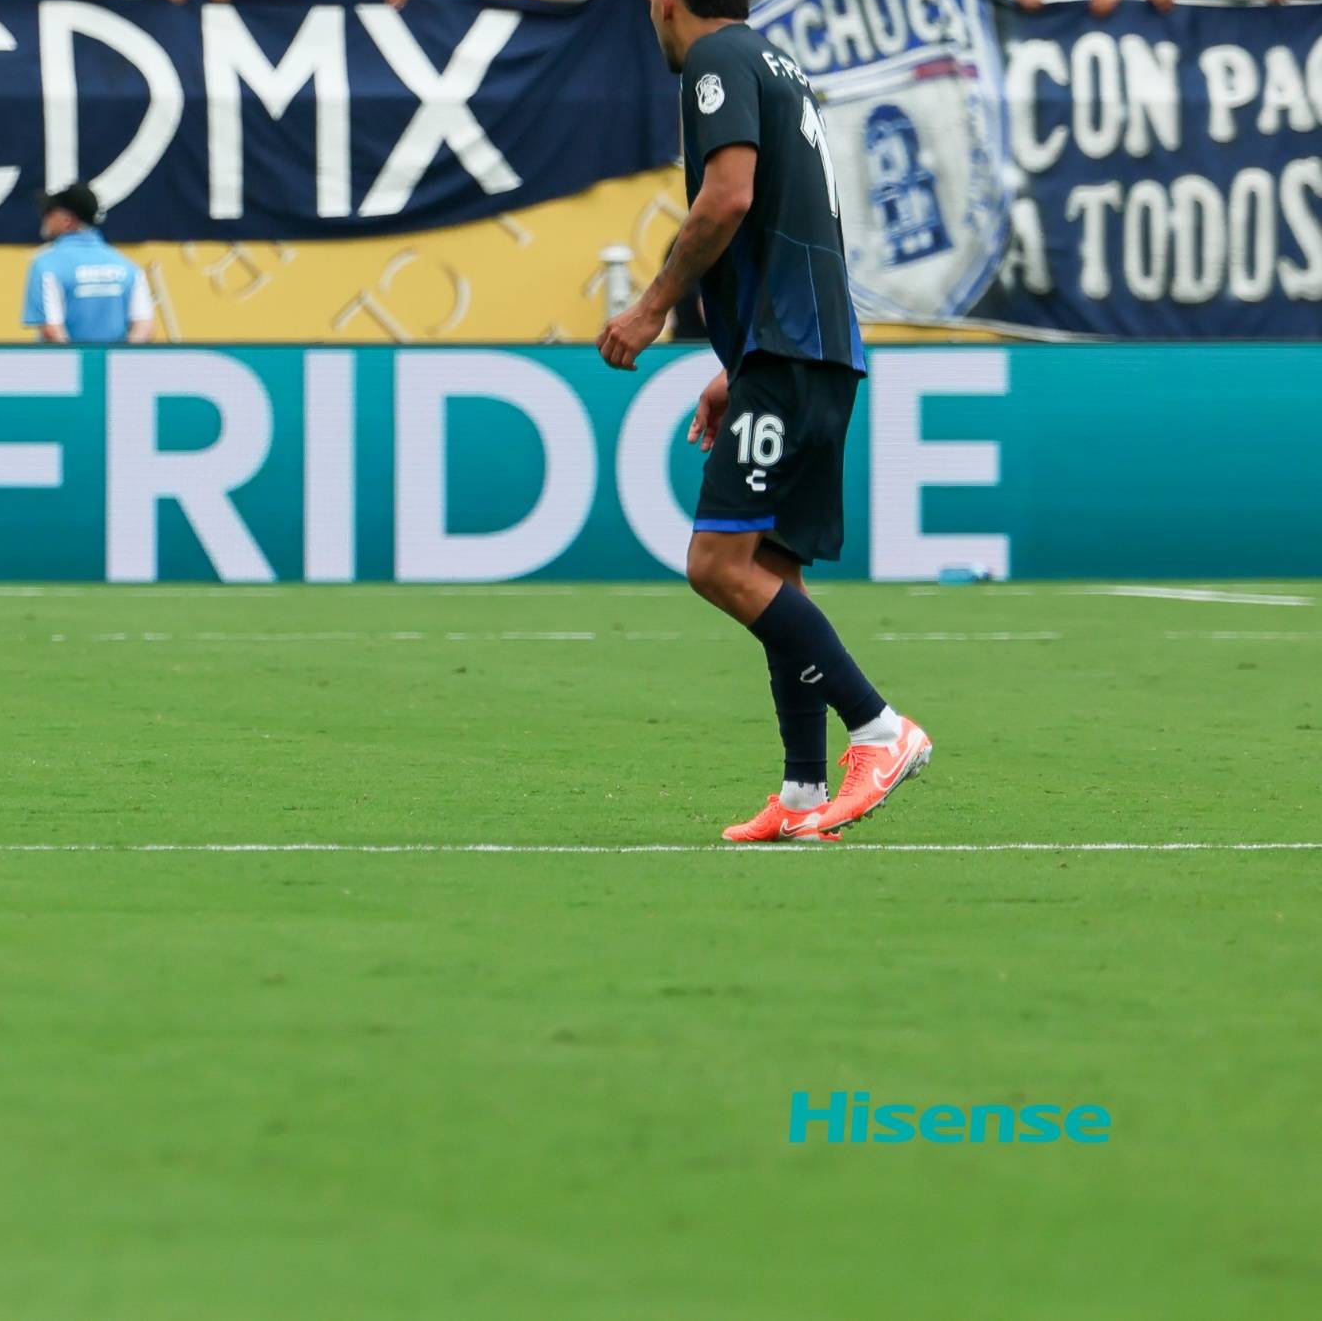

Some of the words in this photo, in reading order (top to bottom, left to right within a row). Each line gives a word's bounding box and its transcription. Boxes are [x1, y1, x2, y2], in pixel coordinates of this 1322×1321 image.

[800, 96, 839, 219] 1
[1006, 31, 1182, 173] CON
[1199, 33, 1322, 144] PA
[1065, 155, 1322, 305] TODOS
[730, 411, 786, 467] 16
